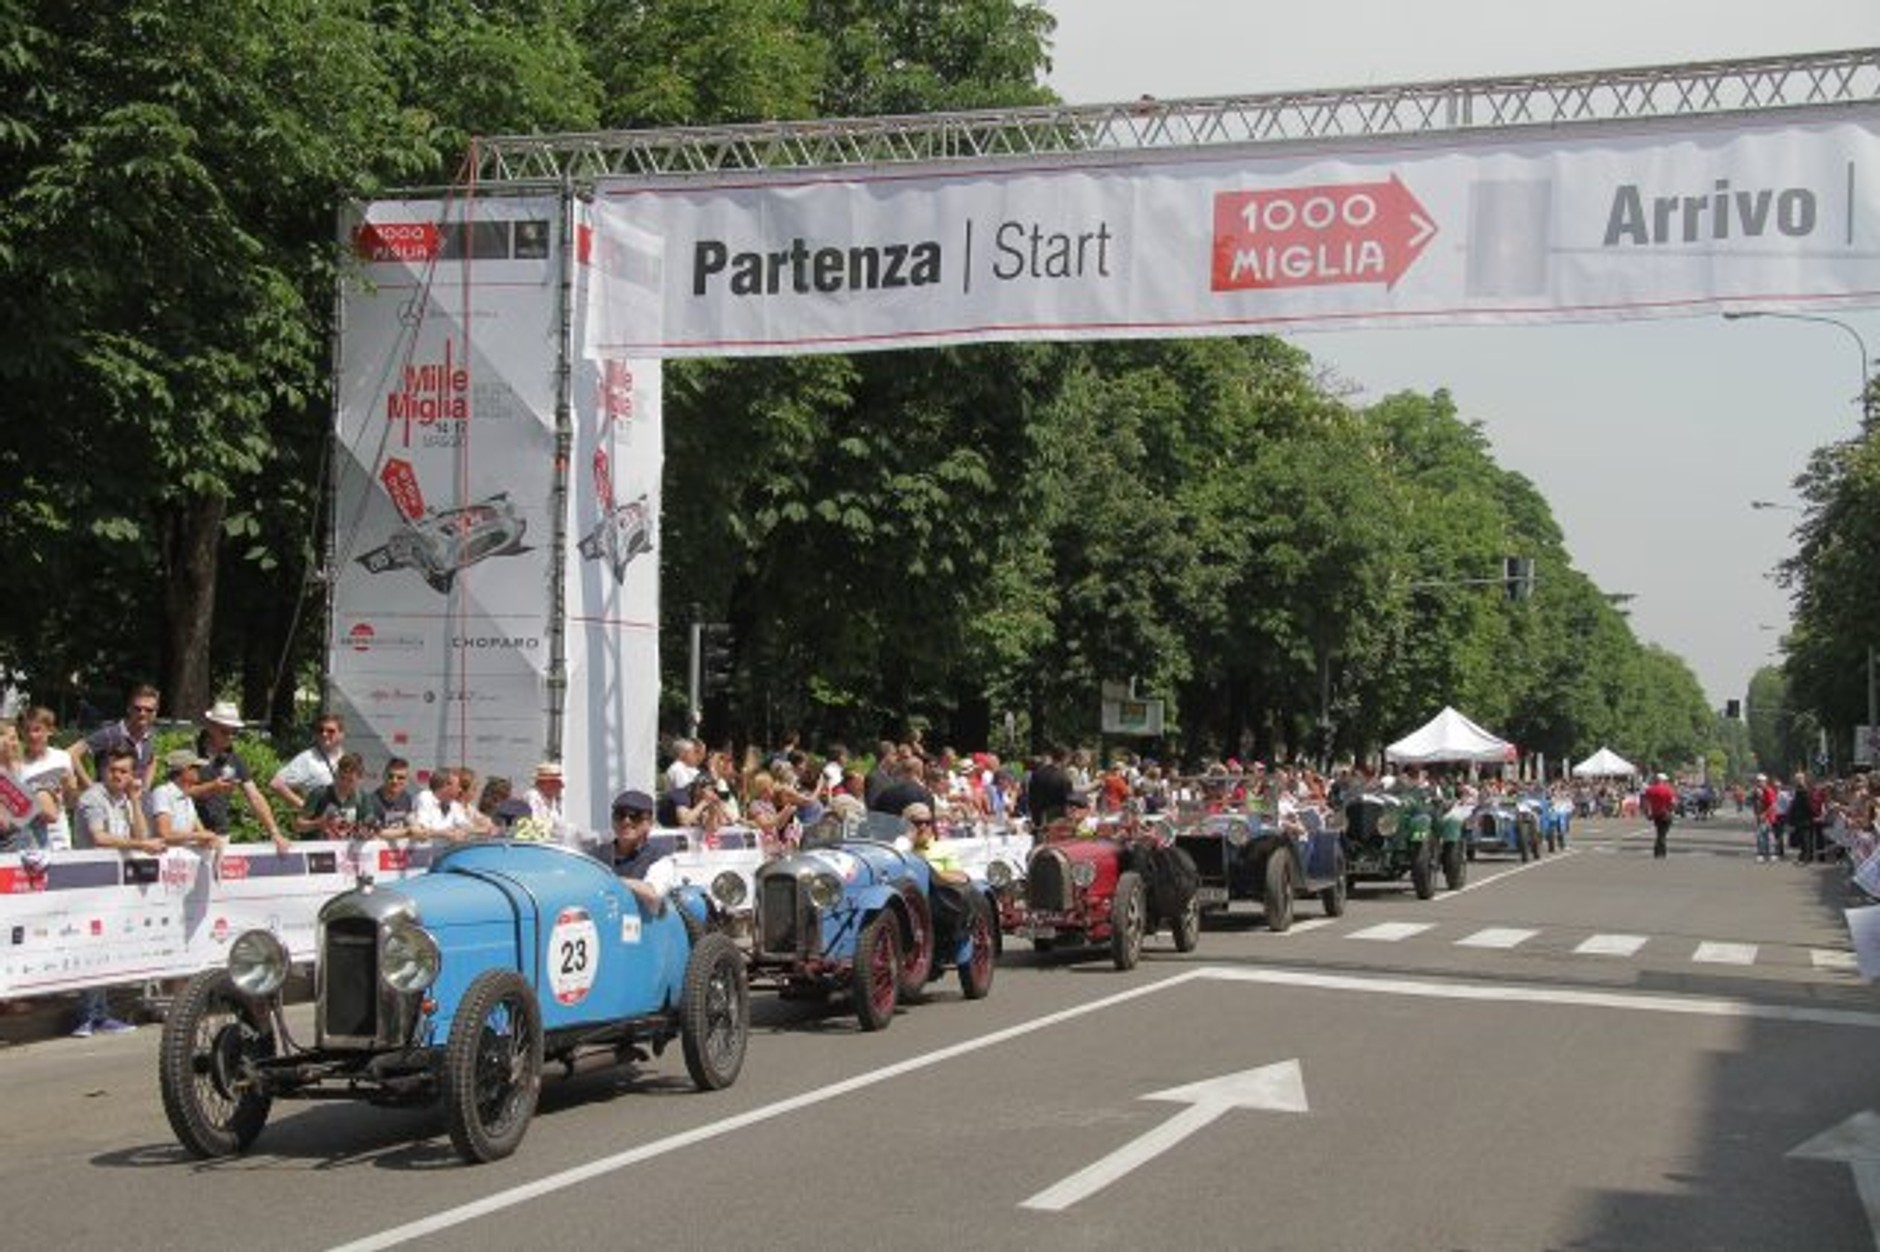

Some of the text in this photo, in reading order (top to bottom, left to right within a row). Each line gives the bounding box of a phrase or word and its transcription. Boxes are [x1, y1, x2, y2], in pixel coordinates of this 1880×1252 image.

[1240, 192, 1377, 235] 1000
[1602, 178, 1818, 247] Arrivo
[693, 219, 1112, 296] Partenza Start
[1230, 238, 1386, 281] MIGLIA
[560, 938, 586, 974] 23
